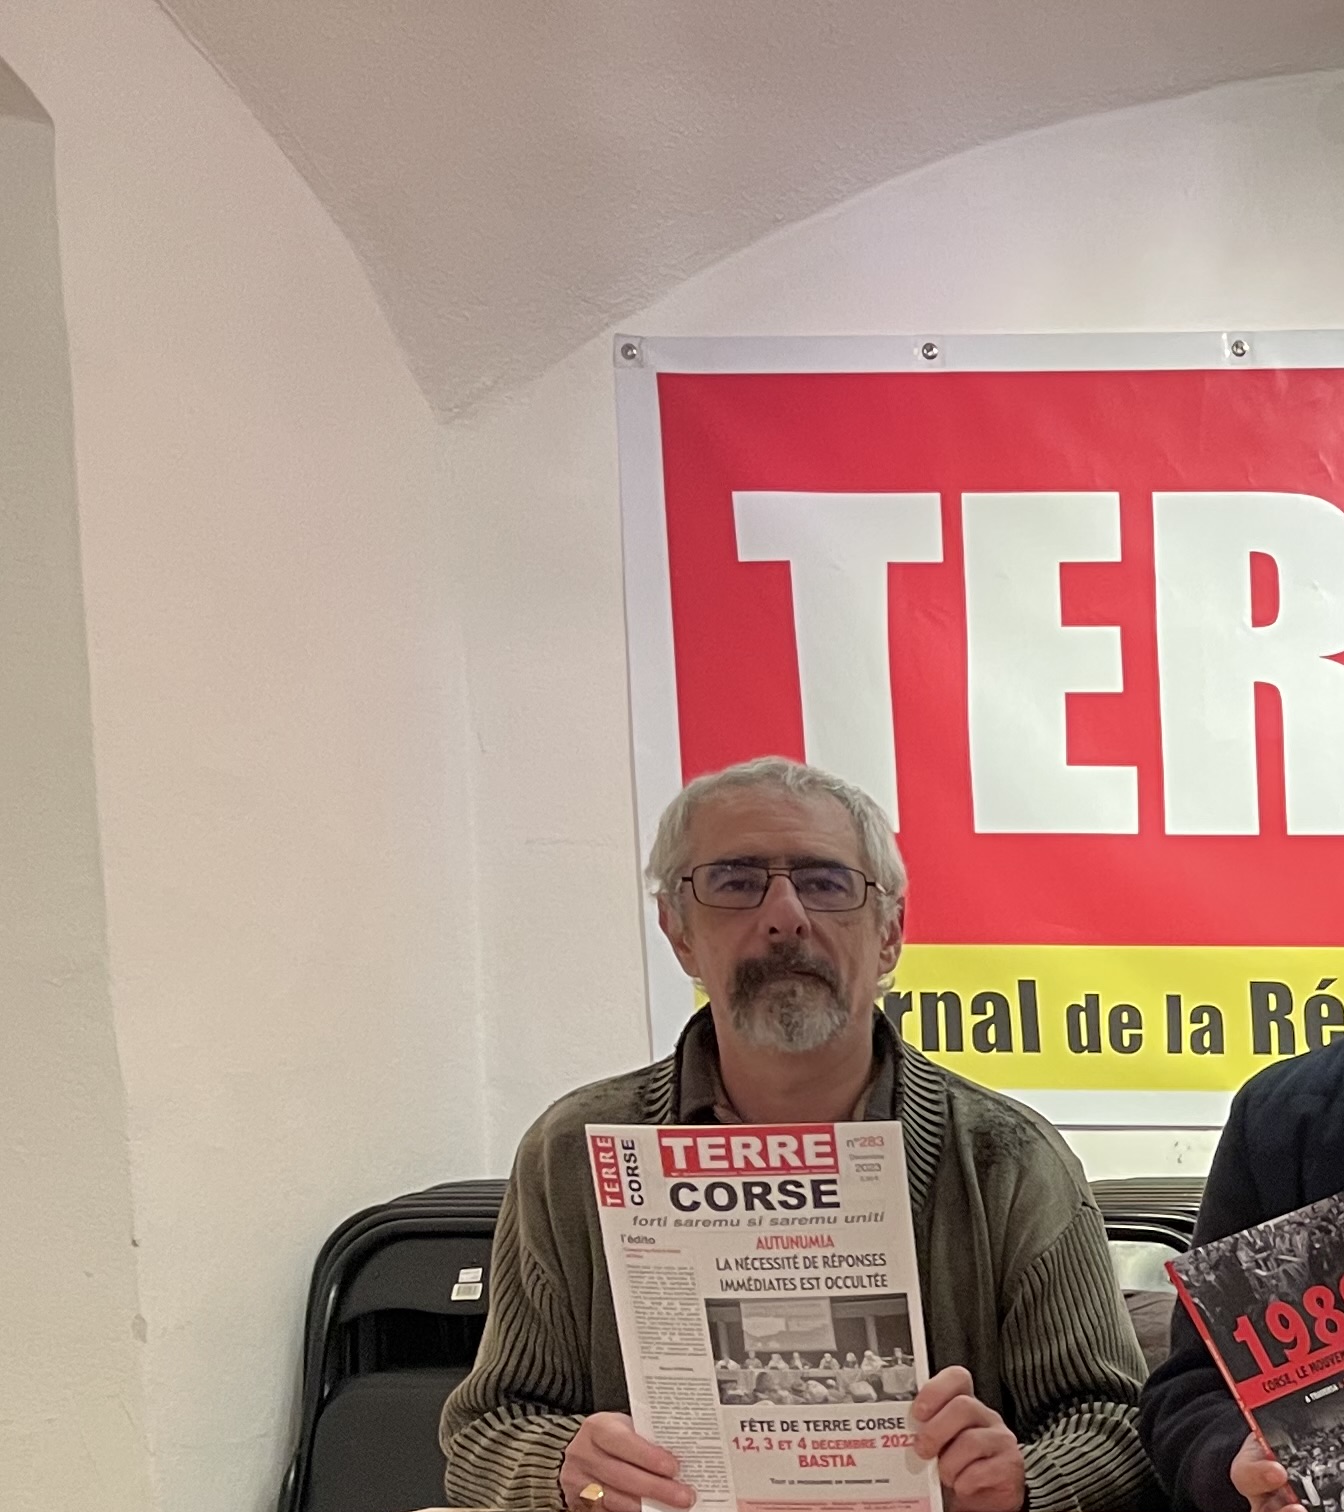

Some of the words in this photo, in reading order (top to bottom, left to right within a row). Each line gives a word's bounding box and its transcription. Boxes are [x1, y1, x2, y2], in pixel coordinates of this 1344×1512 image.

[883, 978, 1041, 1054] rnal
[1066, 993, 1143, 1054] de
[1165, 994, 1226, 1055] la
[661, 1133, 835, 1170] TERRE
[597, 1137, 622, 1206] TERRE
[621, 1138, 644, 1206] CORSE
[669, 1178, 841, 1212] CORSE
[632, 1216, 668, 1227] forti
[673, 1218, 740, 1228] saremu
[747, 1216, 763, 1227] si
[769, 1215, 838, 1226] saremu
[844, 1211, 885, 1224] uniti
[756, 1234, 835, 1250] AUTUNUMIA
[715, 1257, 732, 1271] LA
[735, 1254, 800, 1271] NÉCESSITÉ
[803, 1255, 818, 1269] DE
[822, 1252, 887, 1269] RÉPONSES
[720, 1276, 797, 1292] IMMÉDIATES
[800, 1277, 821, 1291] EST
[825, 1273, 888, 1290] OCCULTÉE
[1296, 1365, 1308, 1379] LE
[740, 1417, 776, 1432] FÊTE
[780, 1420, 799, 1432] DE
[803, 1418, 852, 1432] TERRE
[856, 1417, 905, 1430] CORSE
[763, 1437, 773, 1450] 3
[778, 1440, 792, 1450] ET
[797, 1437, 807, 1450] 4
[798, 1454, 857, 1467] BASTIA
